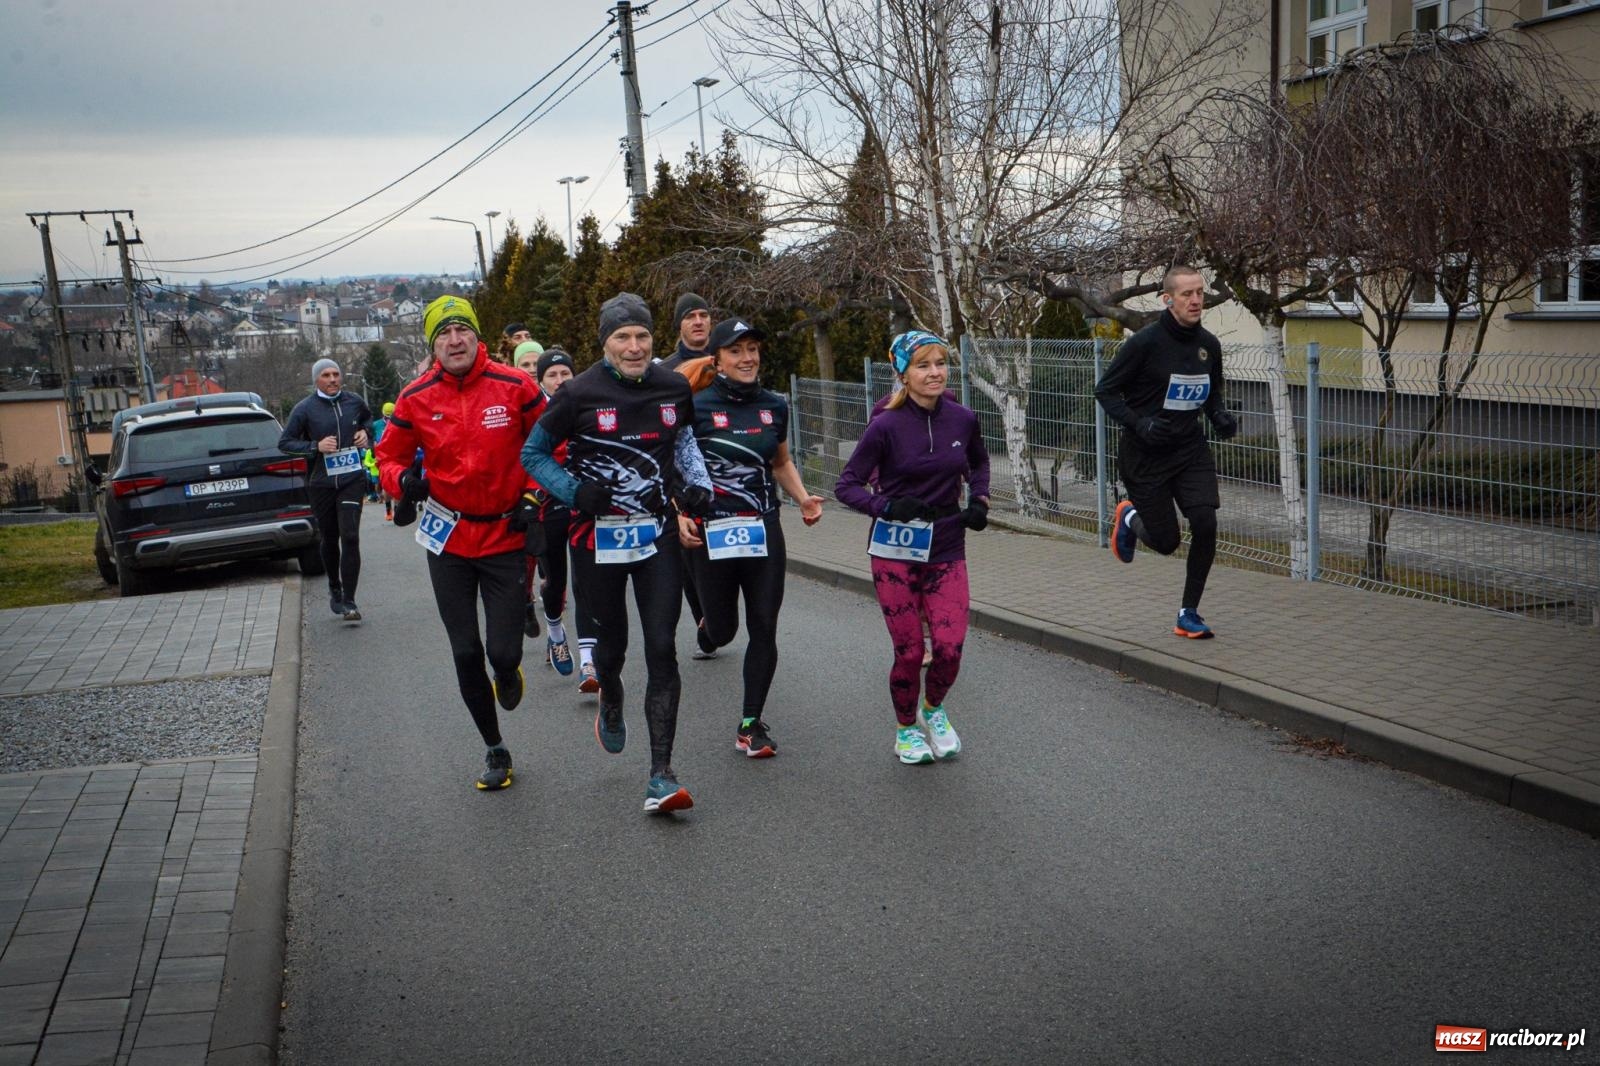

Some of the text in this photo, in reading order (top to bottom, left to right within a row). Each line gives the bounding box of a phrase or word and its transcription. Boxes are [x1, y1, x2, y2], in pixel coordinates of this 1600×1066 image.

[1175, 385, 1204, 400] 179
[332, 453, 355, 467] 196
[192, 479, 245, 495] OP 1239P
[421, 513, 445, 536] 19
[613, 527, 641, 548] 91
[724, 527, 750, 546] 68
[886, 526, 914, 547] 10
